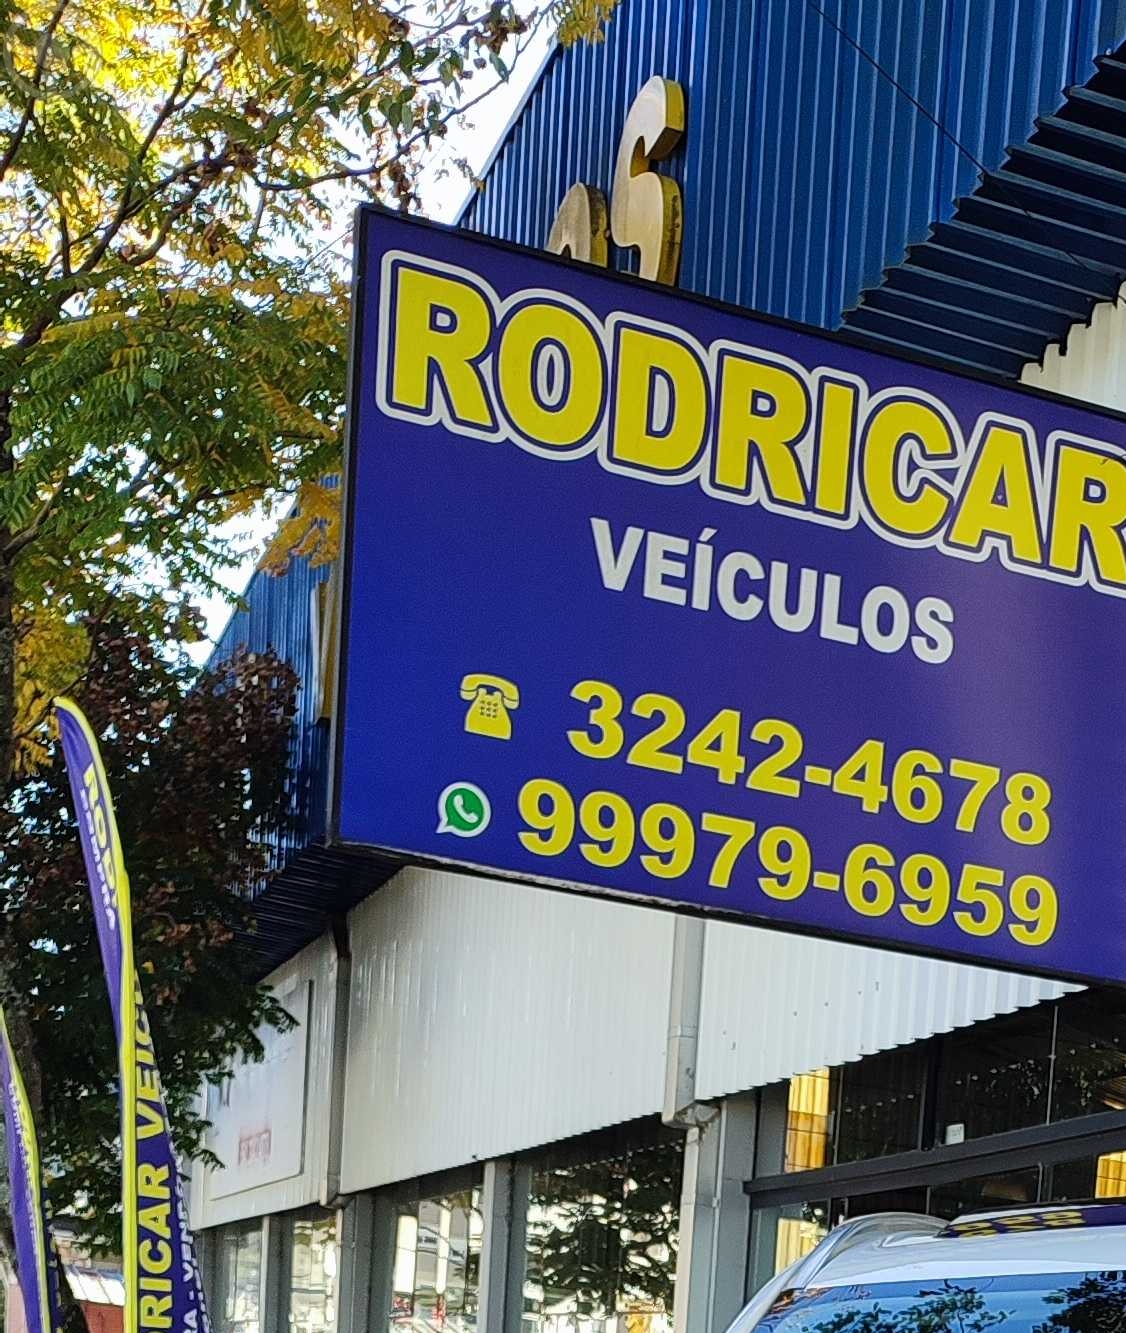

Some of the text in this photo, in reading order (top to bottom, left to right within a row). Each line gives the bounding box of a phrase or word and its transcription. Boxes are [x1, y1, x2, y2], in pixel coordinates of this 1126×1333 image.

[590, 517, 955, 664] VEÍCULOS
[567, 680, 1052, 846] 3242-4678
[517, 779, 1058, 946] 99979-6959
[135, 976, 166, 1140] VEIC
